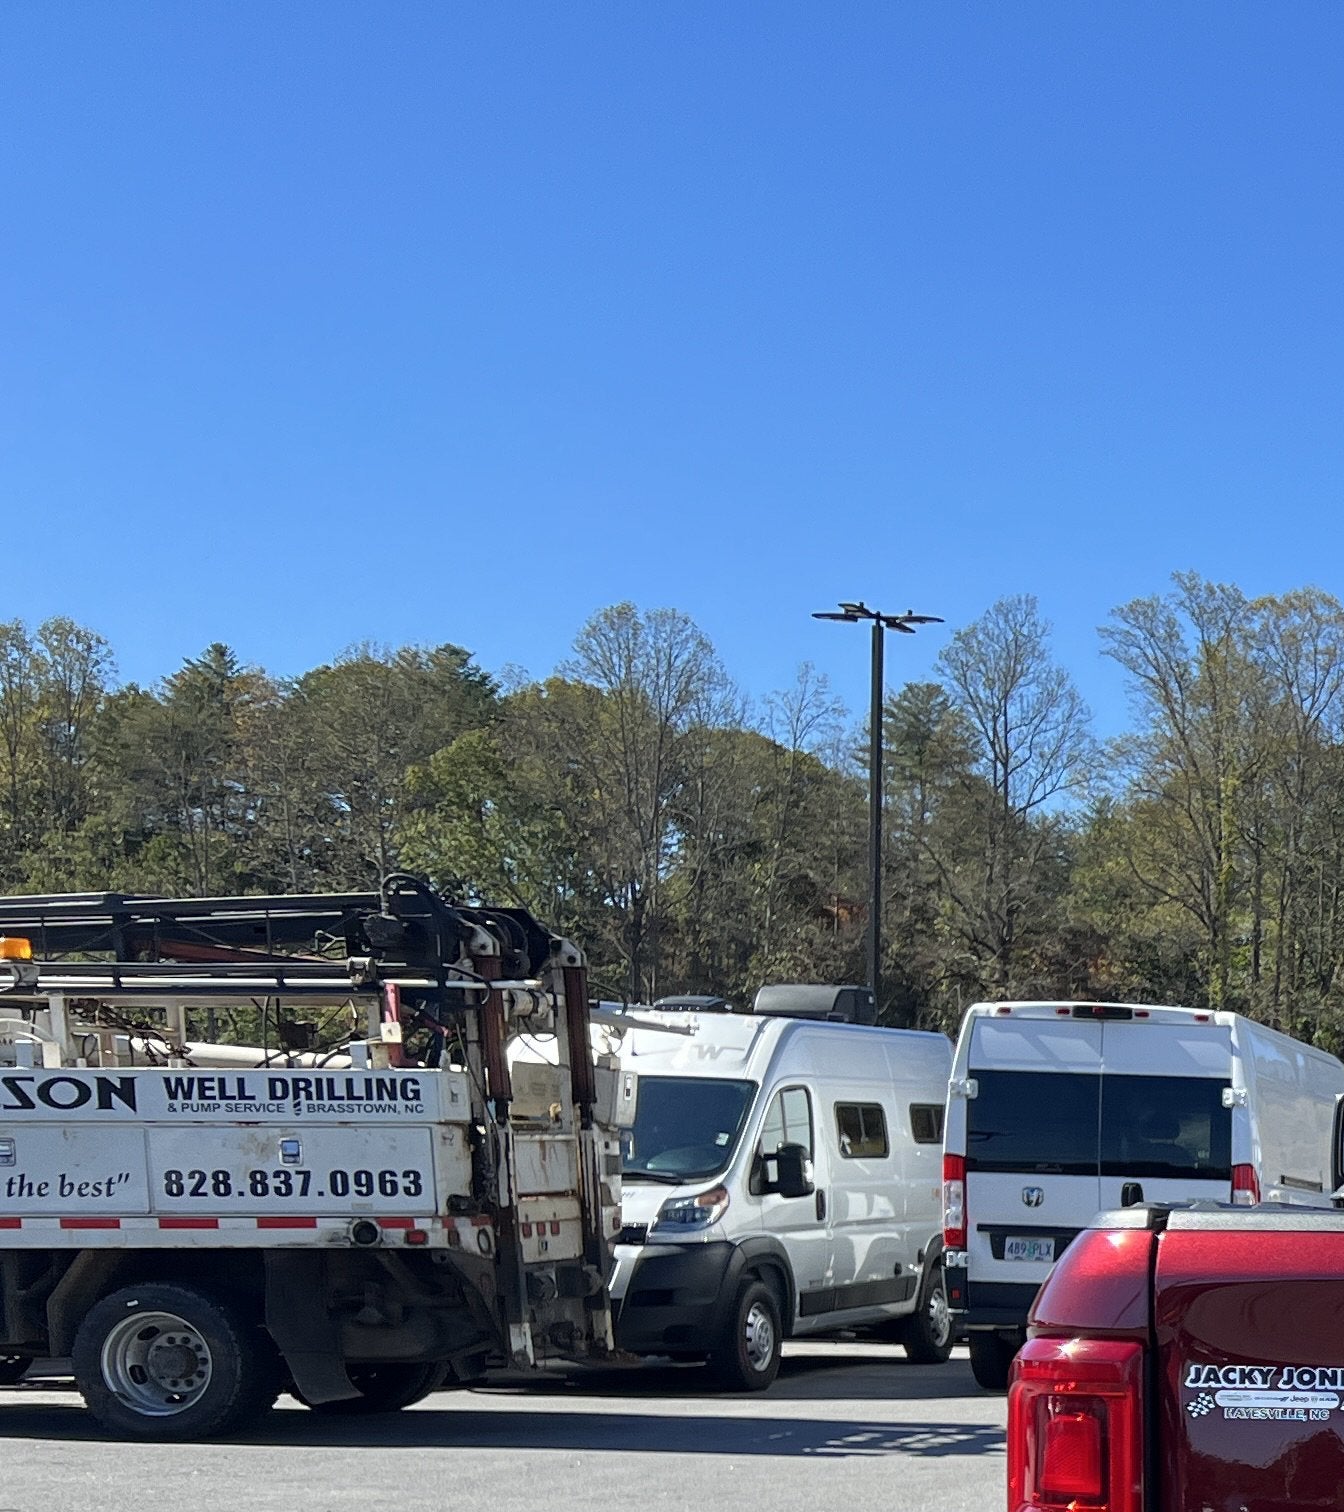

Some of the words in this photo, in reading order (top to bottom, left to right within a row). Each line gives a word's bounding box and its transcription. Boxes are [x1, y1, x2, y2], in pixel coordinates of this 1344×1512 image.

[163, 1077, 256, 1100] WELL
[268, 1077, 421, 1101] DRILLING
[167, 1103, 178, 1113] &
[181, 1103, 221, 1113] PUMP
[224, 1103, 286, 1113] SERVICE
[306, 1103, 400, 1115] BRASSTOWN,
[404, 1104, 424, 1114] NC
[6, 1173, 50, 1198] the
[58, 1172, 130, 1198] best"
[164, 1170, 422, 1197] 828.837.0963
[1185, 1365, 1276, 1388] JACKY
[1309, 1409, 1330, 1420] NC
